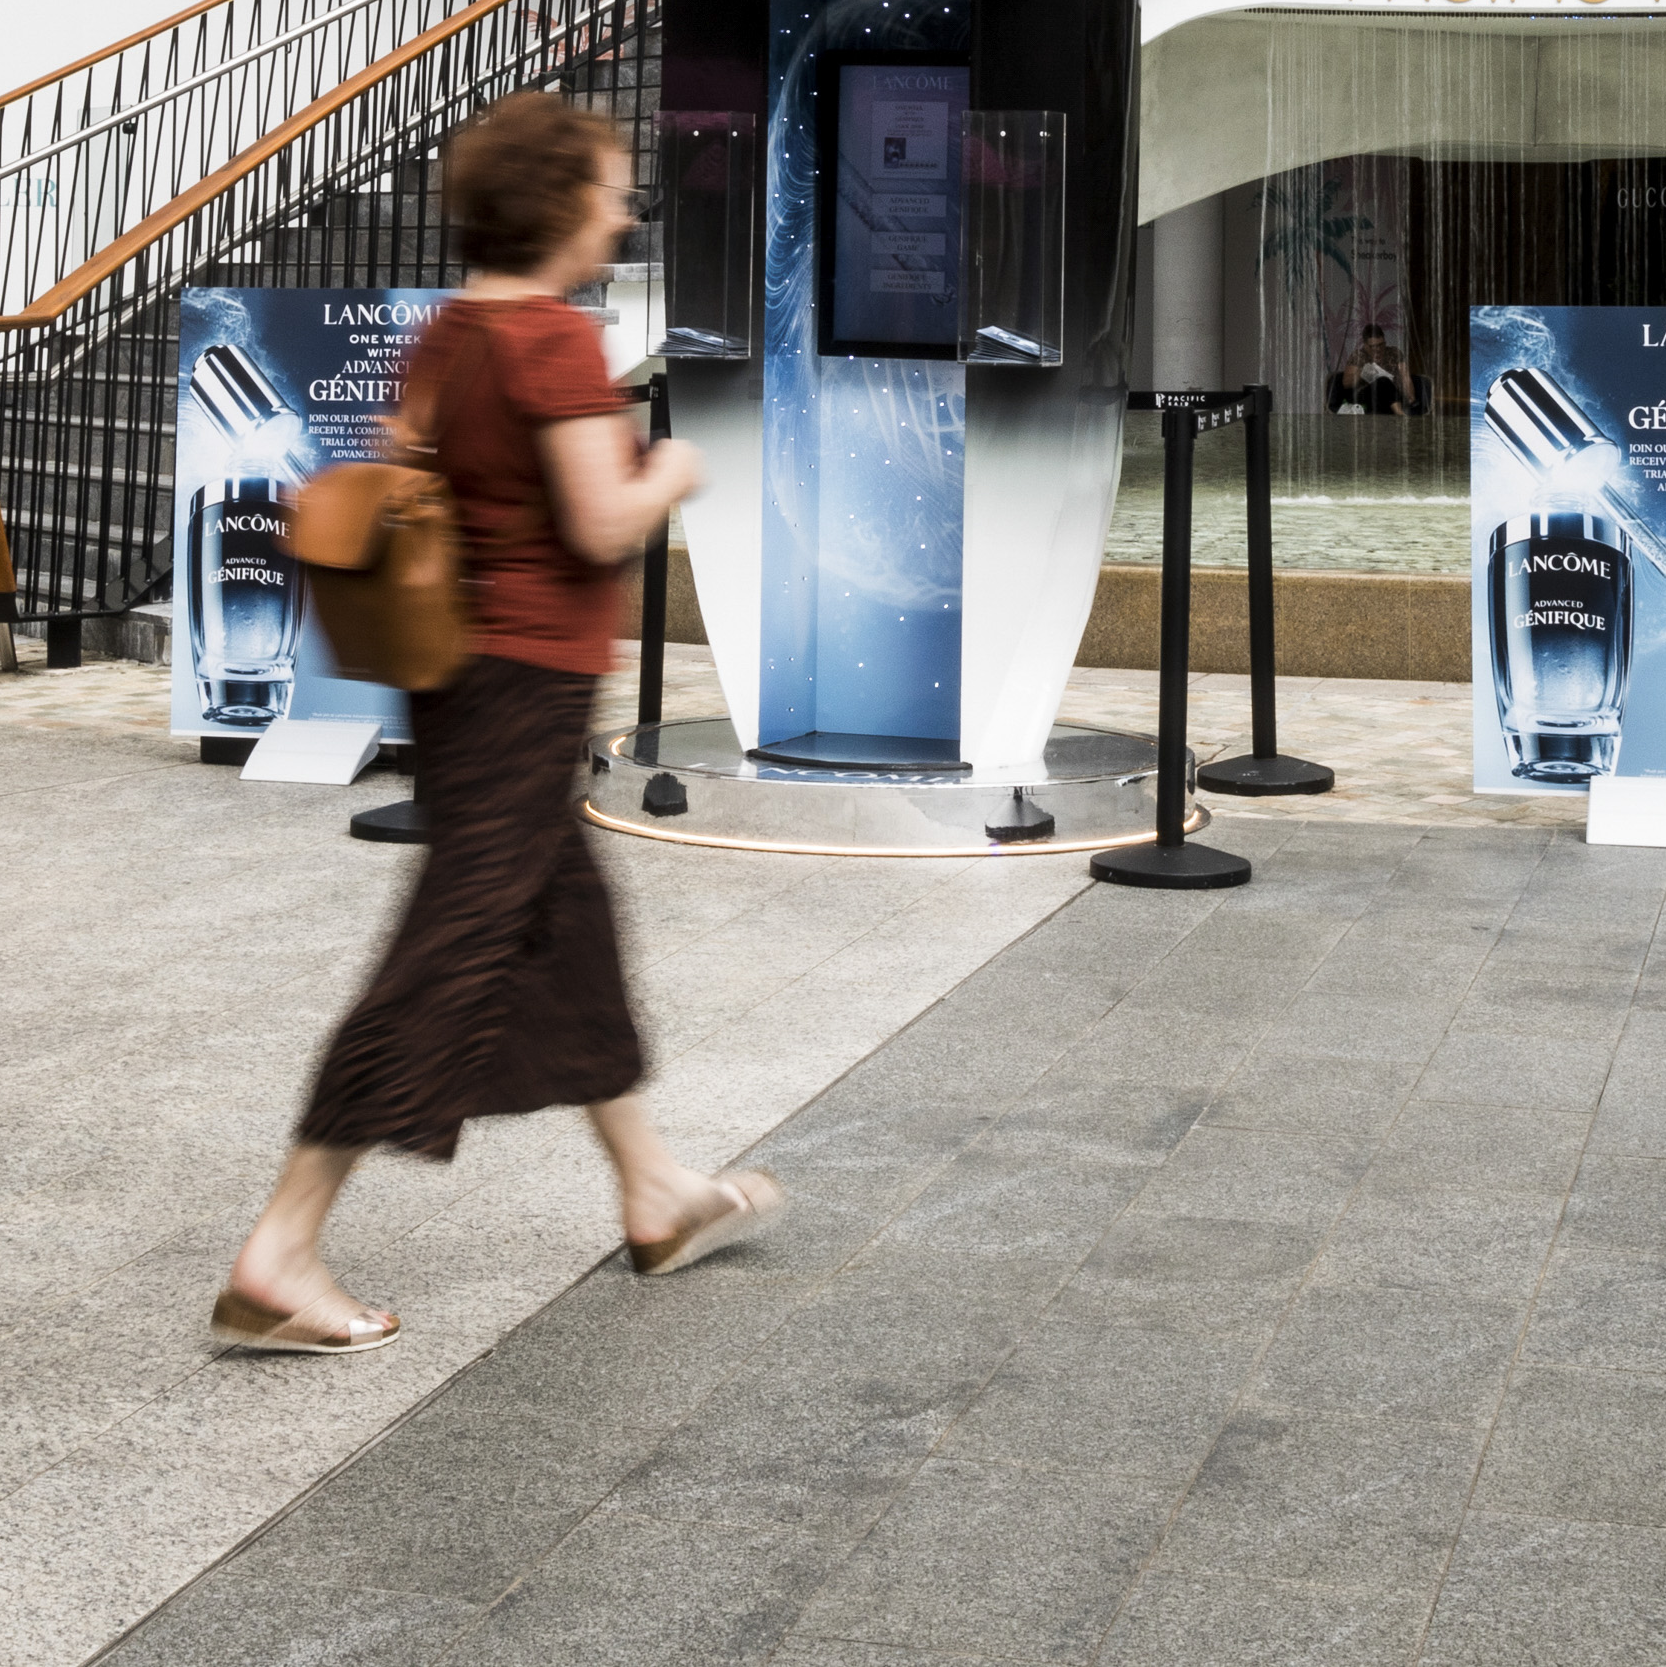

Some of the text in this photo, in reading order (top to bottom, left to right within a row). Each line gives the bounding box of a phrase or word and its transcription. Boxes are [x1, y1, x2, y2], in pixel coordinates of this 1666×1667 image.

[349, 334, 422, 345] ONE WEEK
[367, 348, 401, 358] WITH
[342, 360, 411, 374] ADVANC
[309, 373, 408, 402] GÉNIFI
[309, 414, 329, 424] JOIN
[330, 414, 350, 423] OUR
[308, 426, 398, 436] RECEIVE A COMPLIM
[320, 438, 345, 446] TRIAL
[347, 438, 359, 446] OF
[360, 438, 380, 447] OUR
[1629, 444, 1653, 454] JOIN
[331, 450, 380, 459] ADVANCED
[205, 513, 290, 539] LANCÔME
[225, 557, 266, 566] ADVANCED
[1508, 552, 1611, 579] LANCÔME
[207, 566, 284, 586] GÉNIFIQUE
[1534, 599, 1583, 609] ADVANCED
[1513, 609, 1606, 631] GÉNIFIQUE
